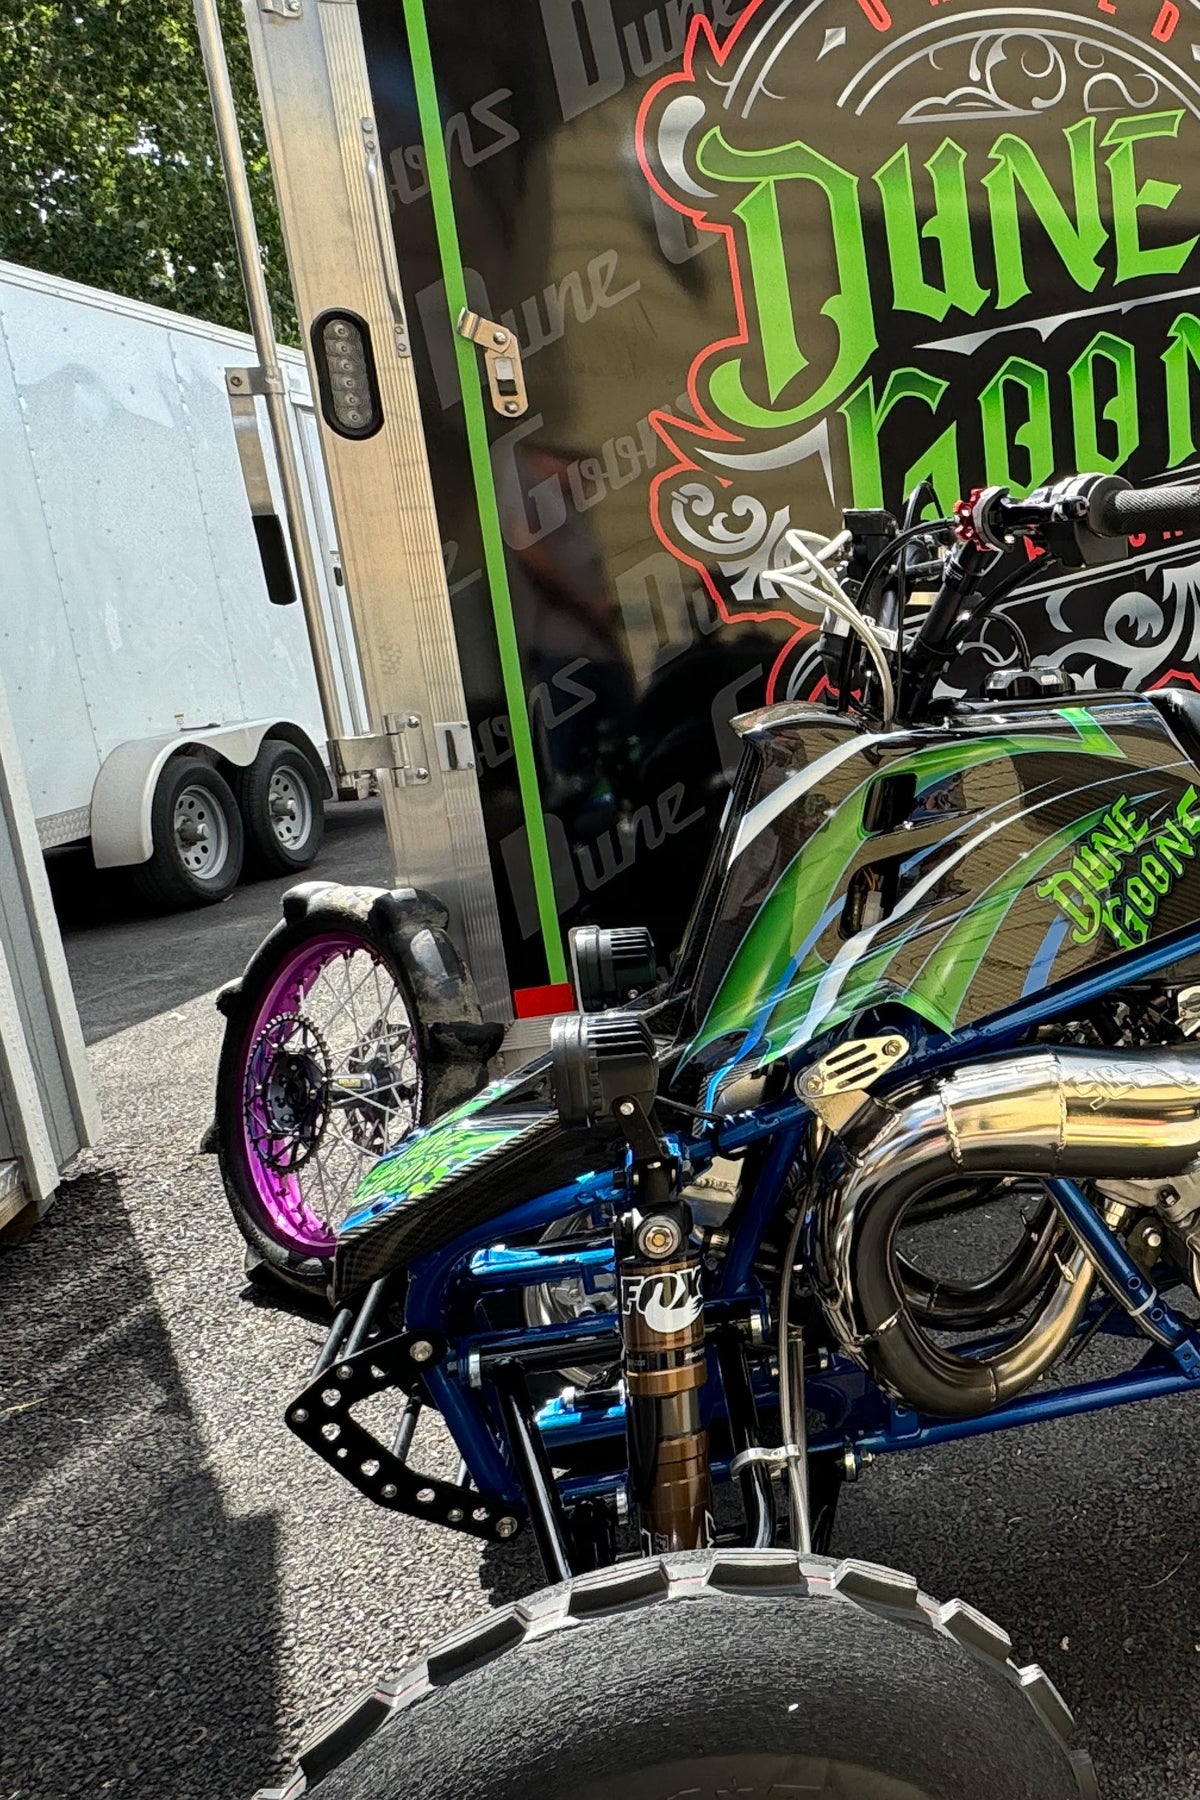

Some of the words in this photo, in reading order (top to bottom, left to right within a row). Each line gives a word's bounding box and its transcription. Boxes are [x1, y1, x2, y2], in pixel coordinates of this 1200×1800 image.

[696, 108, 1200, 429] DUNE
[1036, 785, 1149, 944] DUNE
[620, 1265, 704, 1326] FOX
